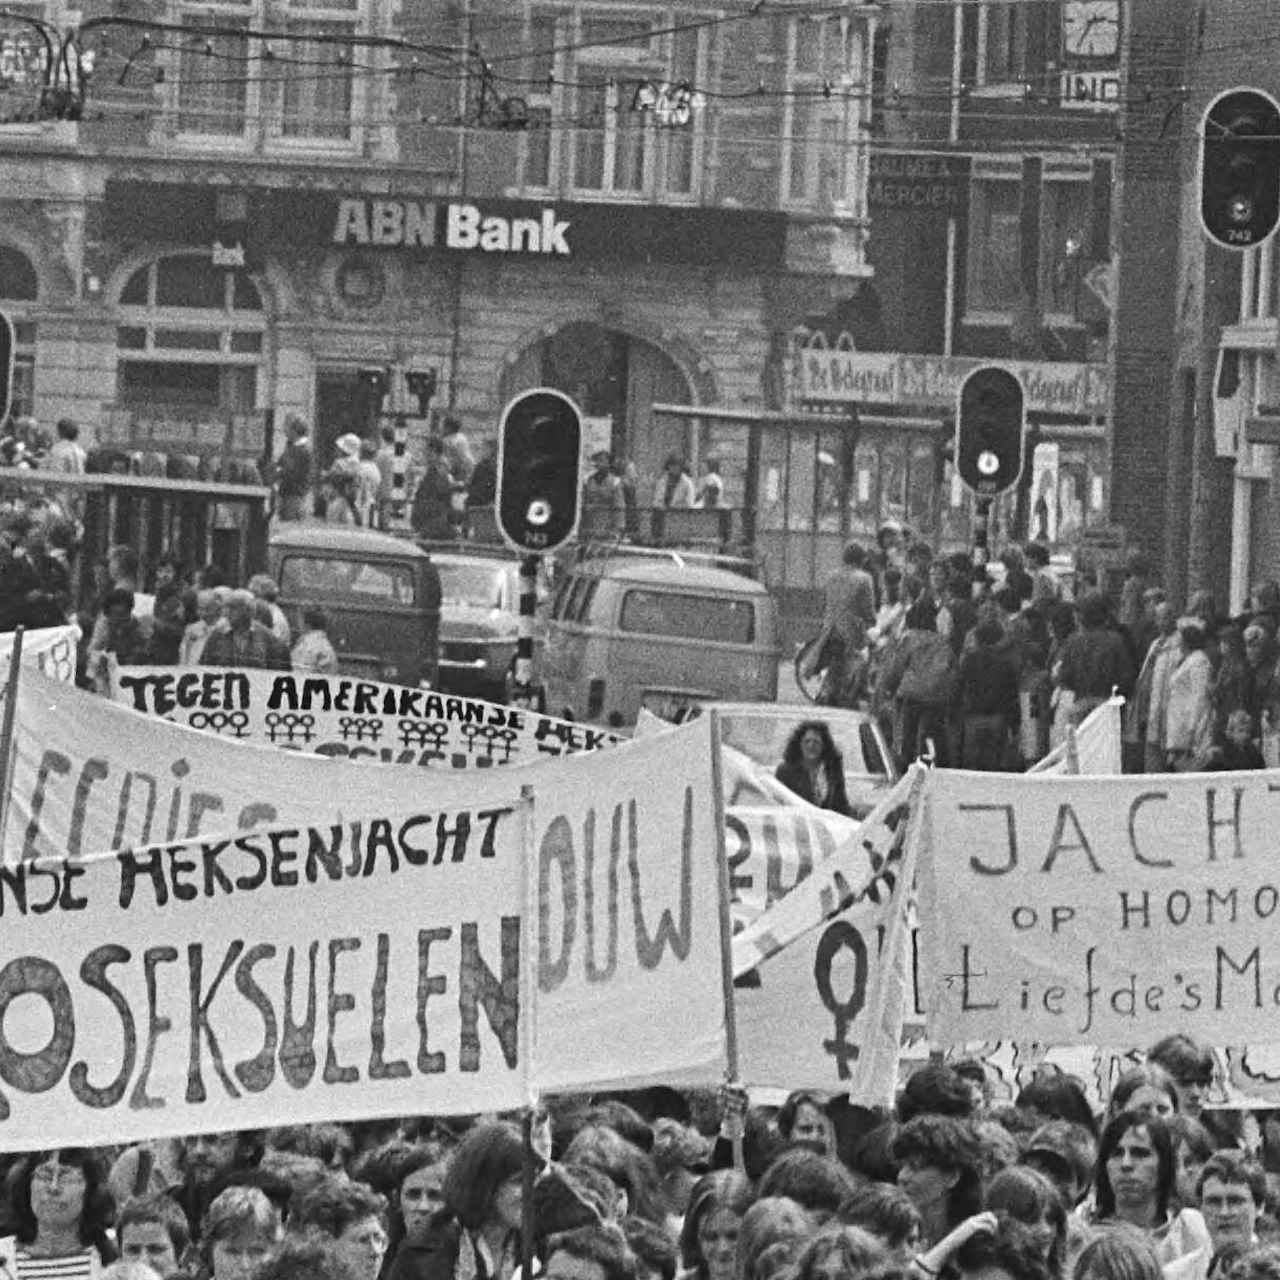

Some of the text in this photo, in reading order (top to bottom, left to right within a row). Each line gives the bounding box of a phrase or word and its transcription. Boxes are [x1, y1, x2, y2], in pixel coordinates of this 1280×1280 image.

[333, 199, 570, 254] ABN Bank
[119, 672, 251, 715] TEGEN
[266, 675, 526, 731] AMERIKAANSE
[118, 806, 515, 909] HEKSENJACHT
[1011, 905, 1077, 934] OP
[961, 943, 1203, 1035] Liefde's
